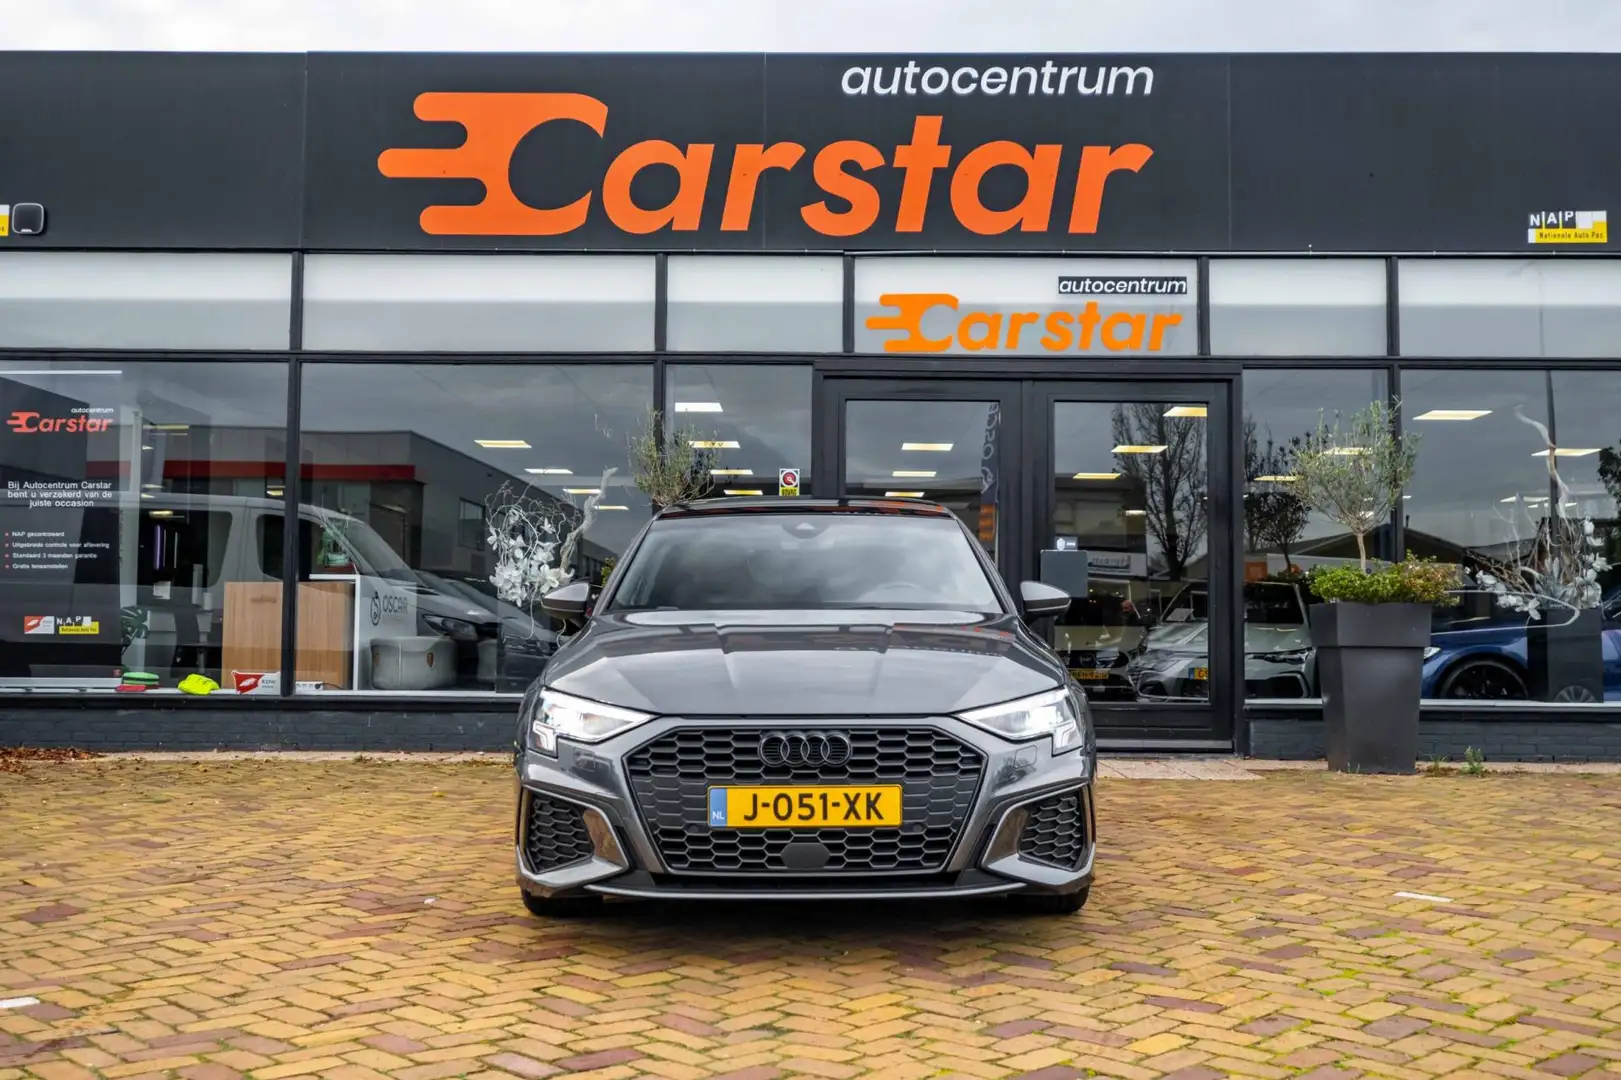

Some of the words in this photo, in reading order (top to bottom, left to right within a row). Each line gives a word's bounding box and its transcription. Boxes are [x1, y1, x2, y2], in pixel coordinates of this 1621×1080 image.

[841, 61, 1154, 96] autocentrum
[378, 92, 1153, 237] Carstar
[1059, 278, 1187, 293] autocentrum
[865, 293, 1183, 353] Carstar
[6, 411, 114, 433] Carstar
[7, 481, 20, 490] Bij
[23, 481, 78, 489] Autocentrum
[80, 481, 112, 489] Carstar
[7, 490, 28, 498] bent
[40, 490, 81, 498] verzekerd
[101, 490, 113, 498] de
[29, 500, 52, 508] juiste
[712, 811, 725, 820] NL
[743, 792, 884, 821] J-051-XK
